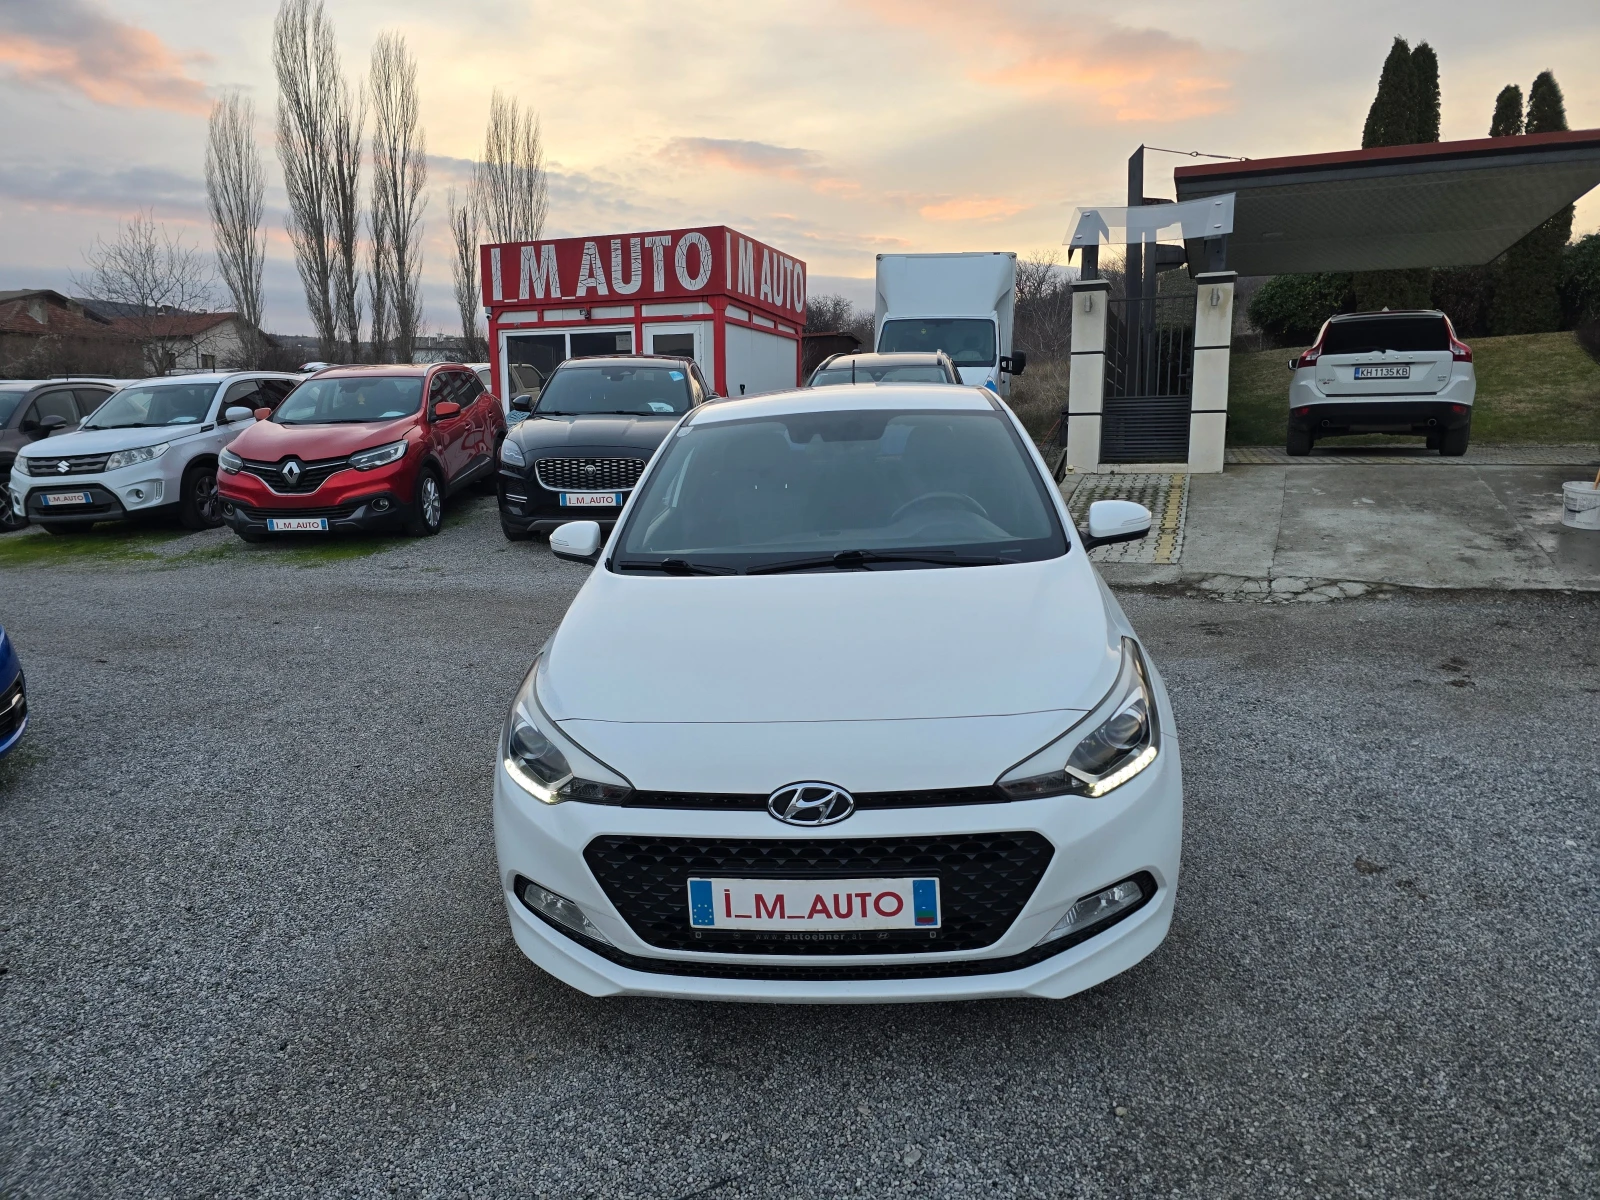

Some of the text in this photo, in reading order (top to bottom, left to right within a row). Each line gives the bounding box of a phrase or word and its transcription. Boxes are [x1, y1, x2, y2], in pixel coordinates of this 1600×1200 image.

[760, 248, 805, 313] AUTO
[1360, 367, 1408, 377] KH 1135 KB
